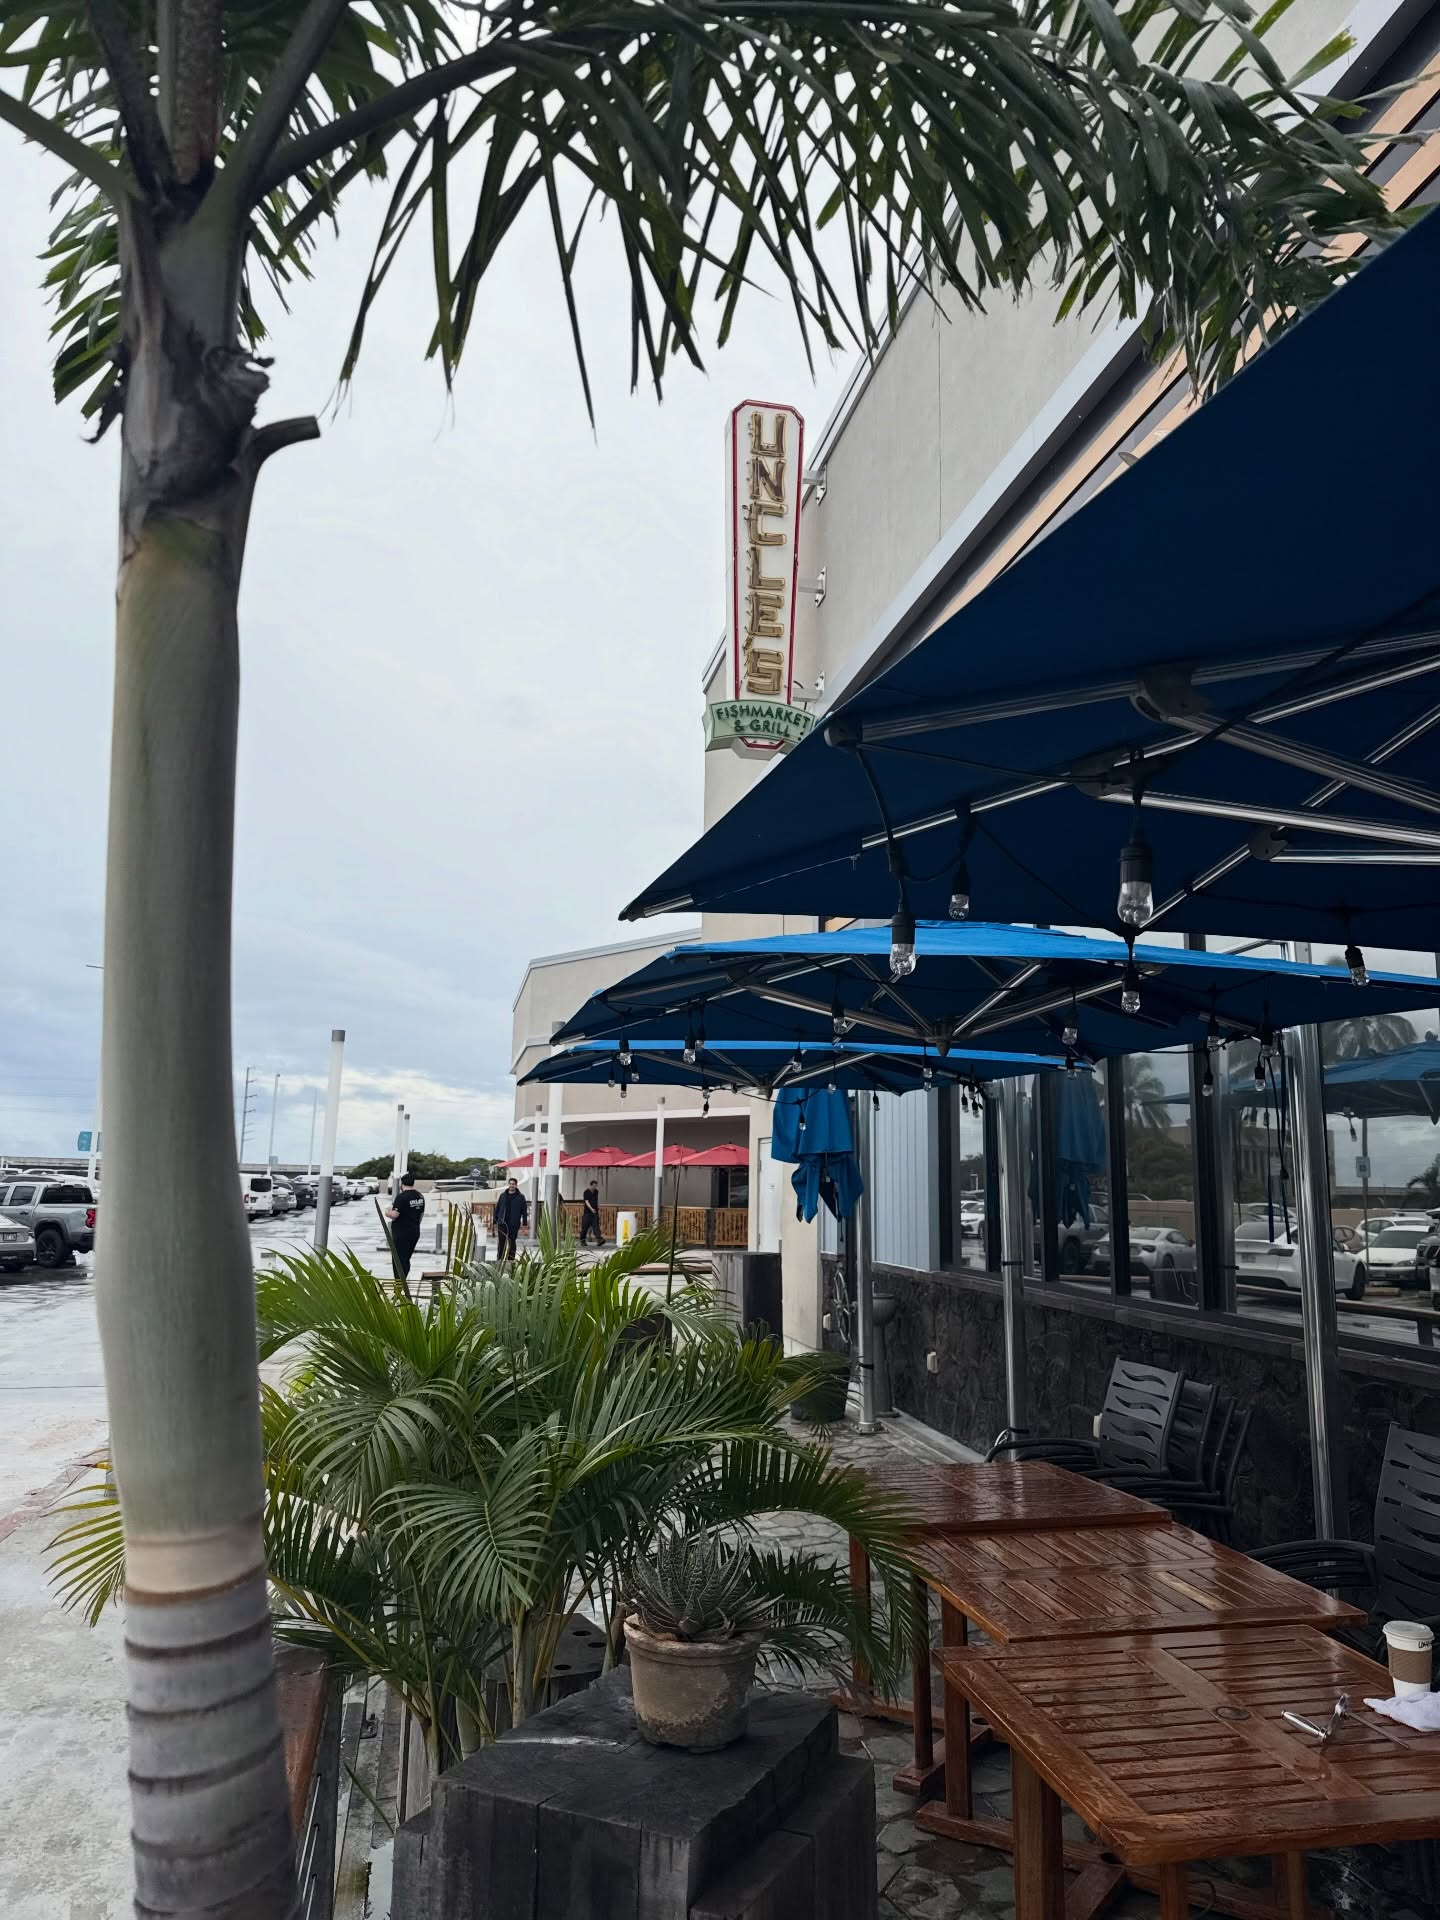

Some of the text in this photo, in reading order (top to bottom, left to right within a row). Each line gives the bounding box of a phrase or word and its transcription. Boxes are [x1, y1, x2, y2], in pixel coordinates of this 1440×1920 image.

[747, 411, 788, 695] UNCLES
[716, 705, 811, 729] FISHMARKET
[734, 719, 791, 738] & GRILL
